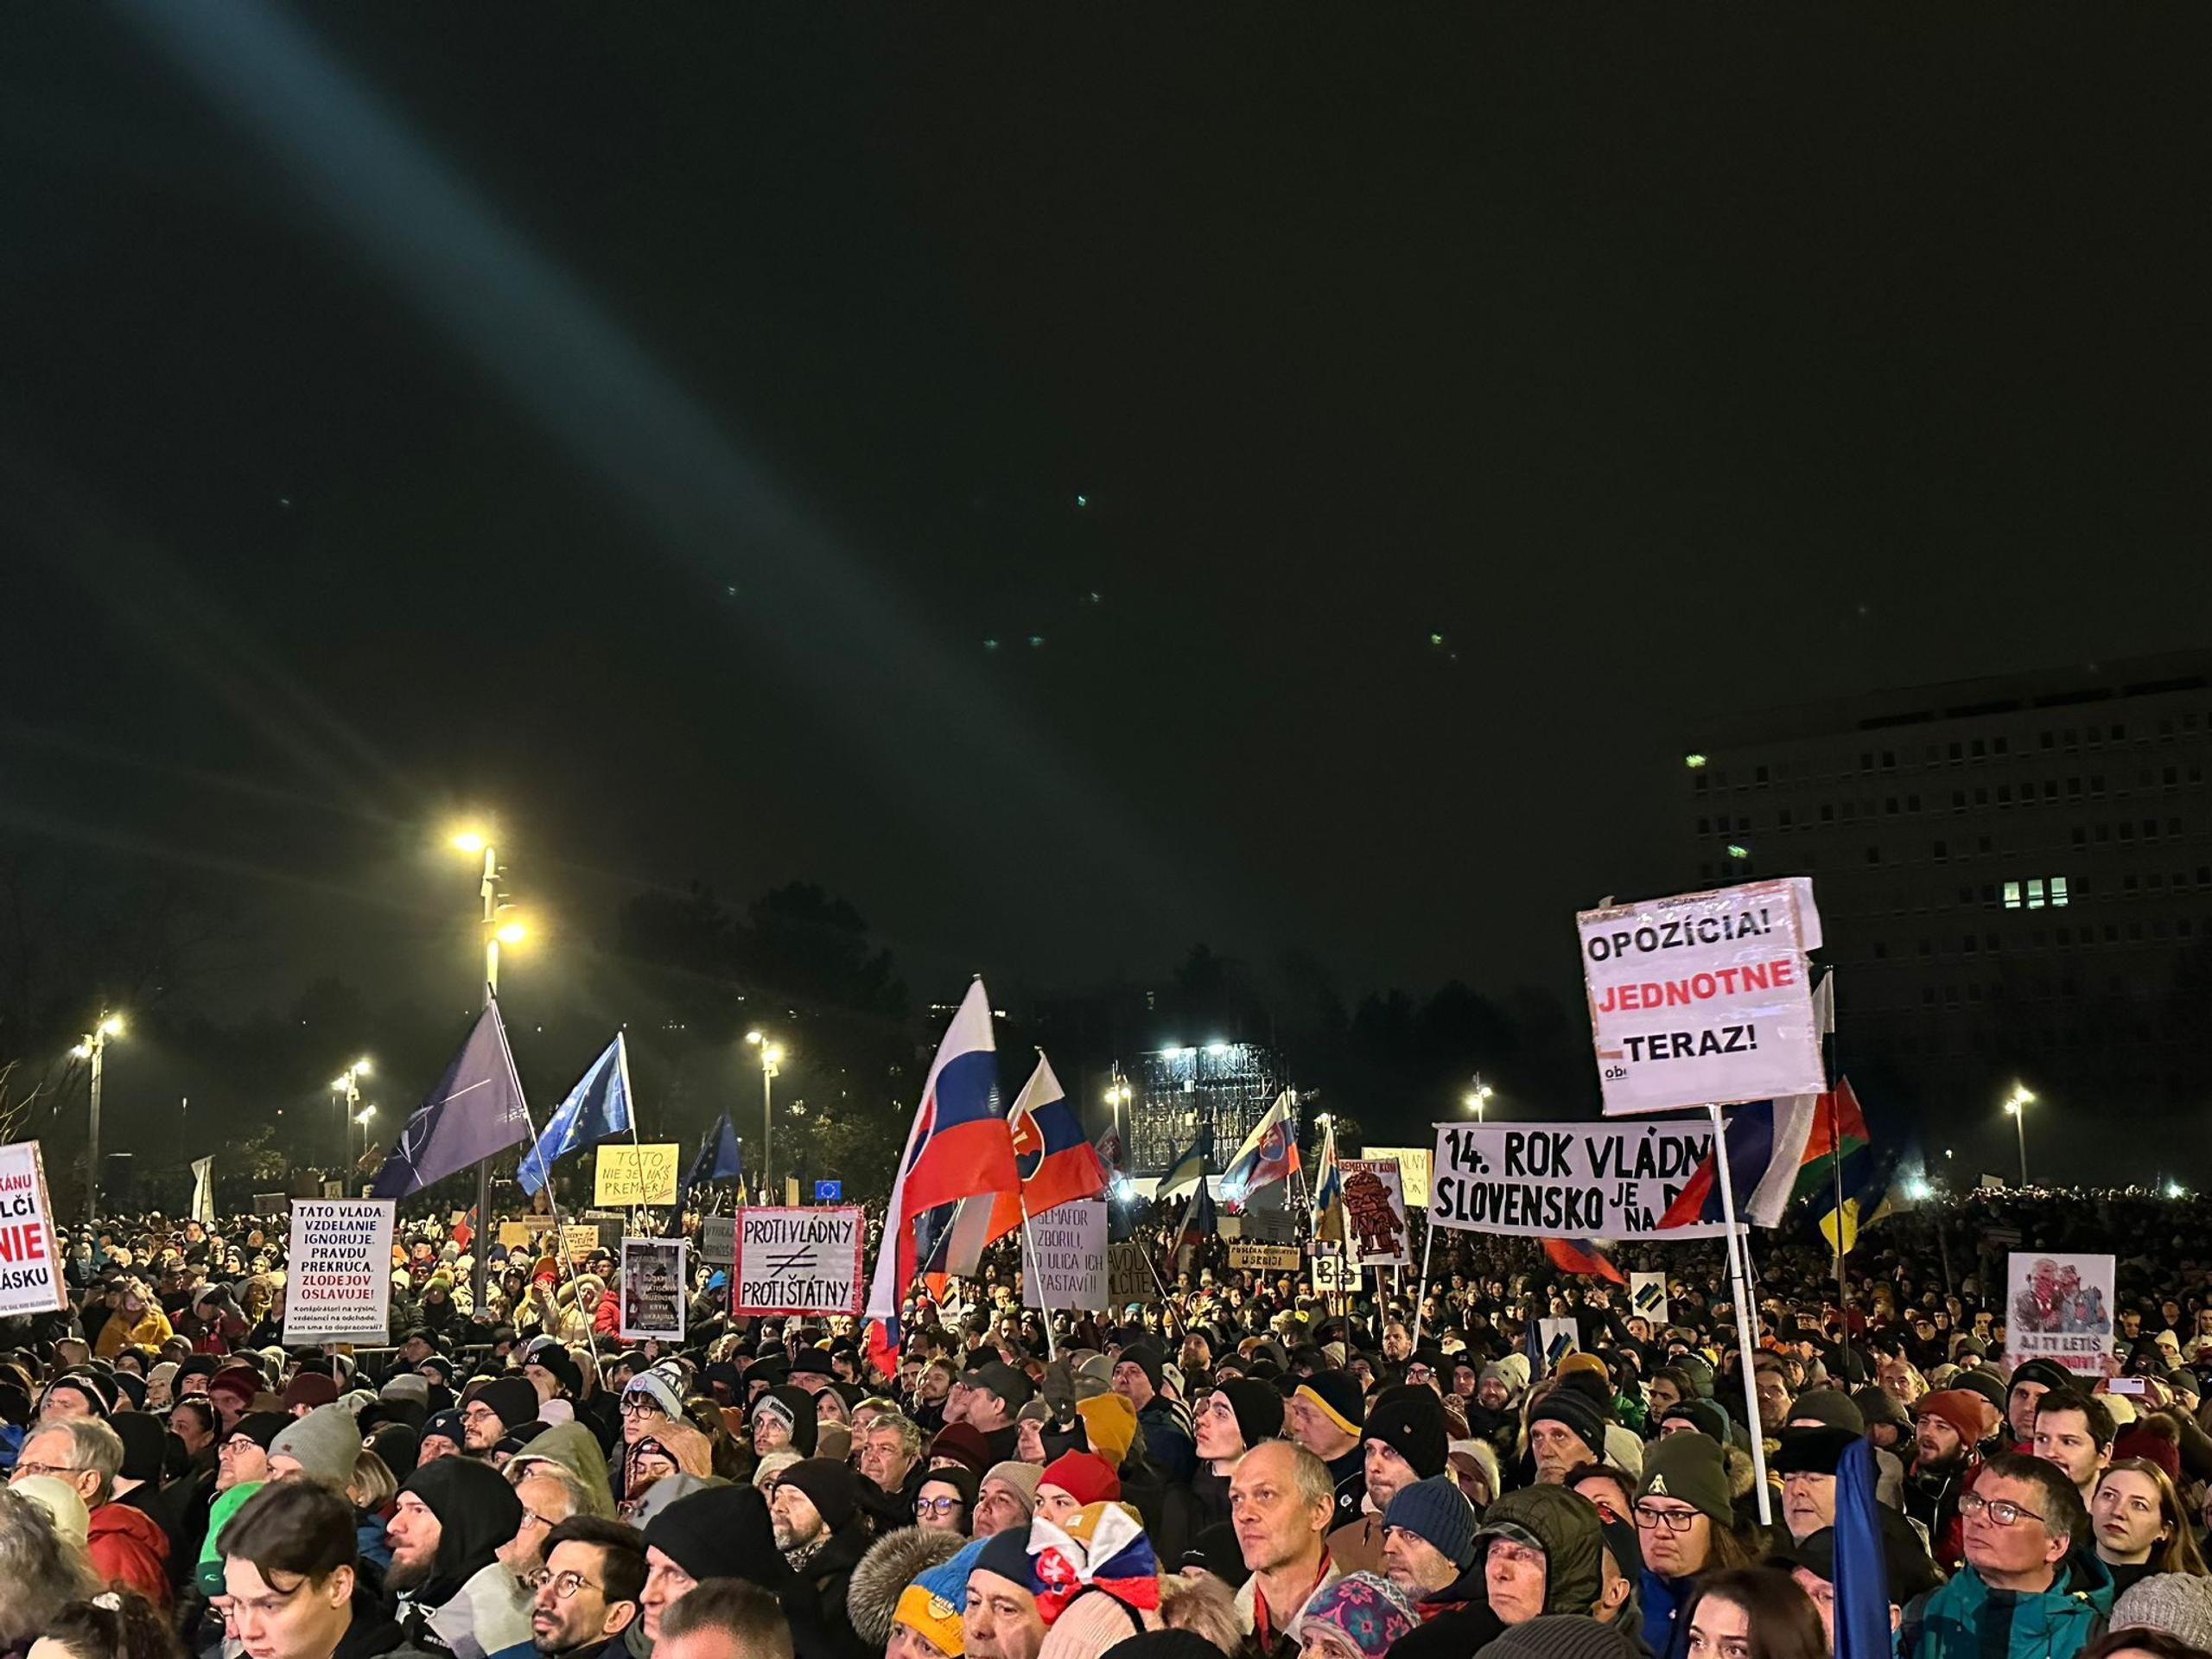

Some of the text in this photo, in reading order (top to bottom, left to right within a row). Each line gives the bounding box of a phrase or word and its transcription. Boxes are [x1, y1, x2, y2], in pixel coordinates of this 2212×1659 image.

[1587, 908, 1771, 961] OPOZÍCIA!
[1599, 959, 1794, 1013] JEDNOTNE
[1624, 1024, 1758, 1062] TERAZ!
[616, 1151, 664, 1166] TOTO
[1445, 1126, 1715, 1179] 14. ROK VLÁDN
[602, 1168, 621, 1179] NIE
[626, 1169, 639, 1179] JE
[1434, 1176, 1603, 1230] SLOVENSKO
[1609, 1182, 1638, 1208] JE
[1624, 1206, 1656, 1232] NA
[305, 1220, 377, 1231] VZDELANIE
[744, 1215, 854, 1244] PROTIVLÁDNY
[304, 1234, 375, 1244] IGNORUJE.
[311, 1247, 366, 1258] PRAVDU
[1048, 1253, 1079, 1270] ULICA
[1085, 1255, 1103, 1272] ICH
[0, 1267, 49, 1290] ÁSKU
[302, 1275, 372, 1286] ZLODEJOV
[302, 1288, 374, 1300] OSLAVUJE!
[741, 1274, 849, 1306] PROTIŠTÁTNY
